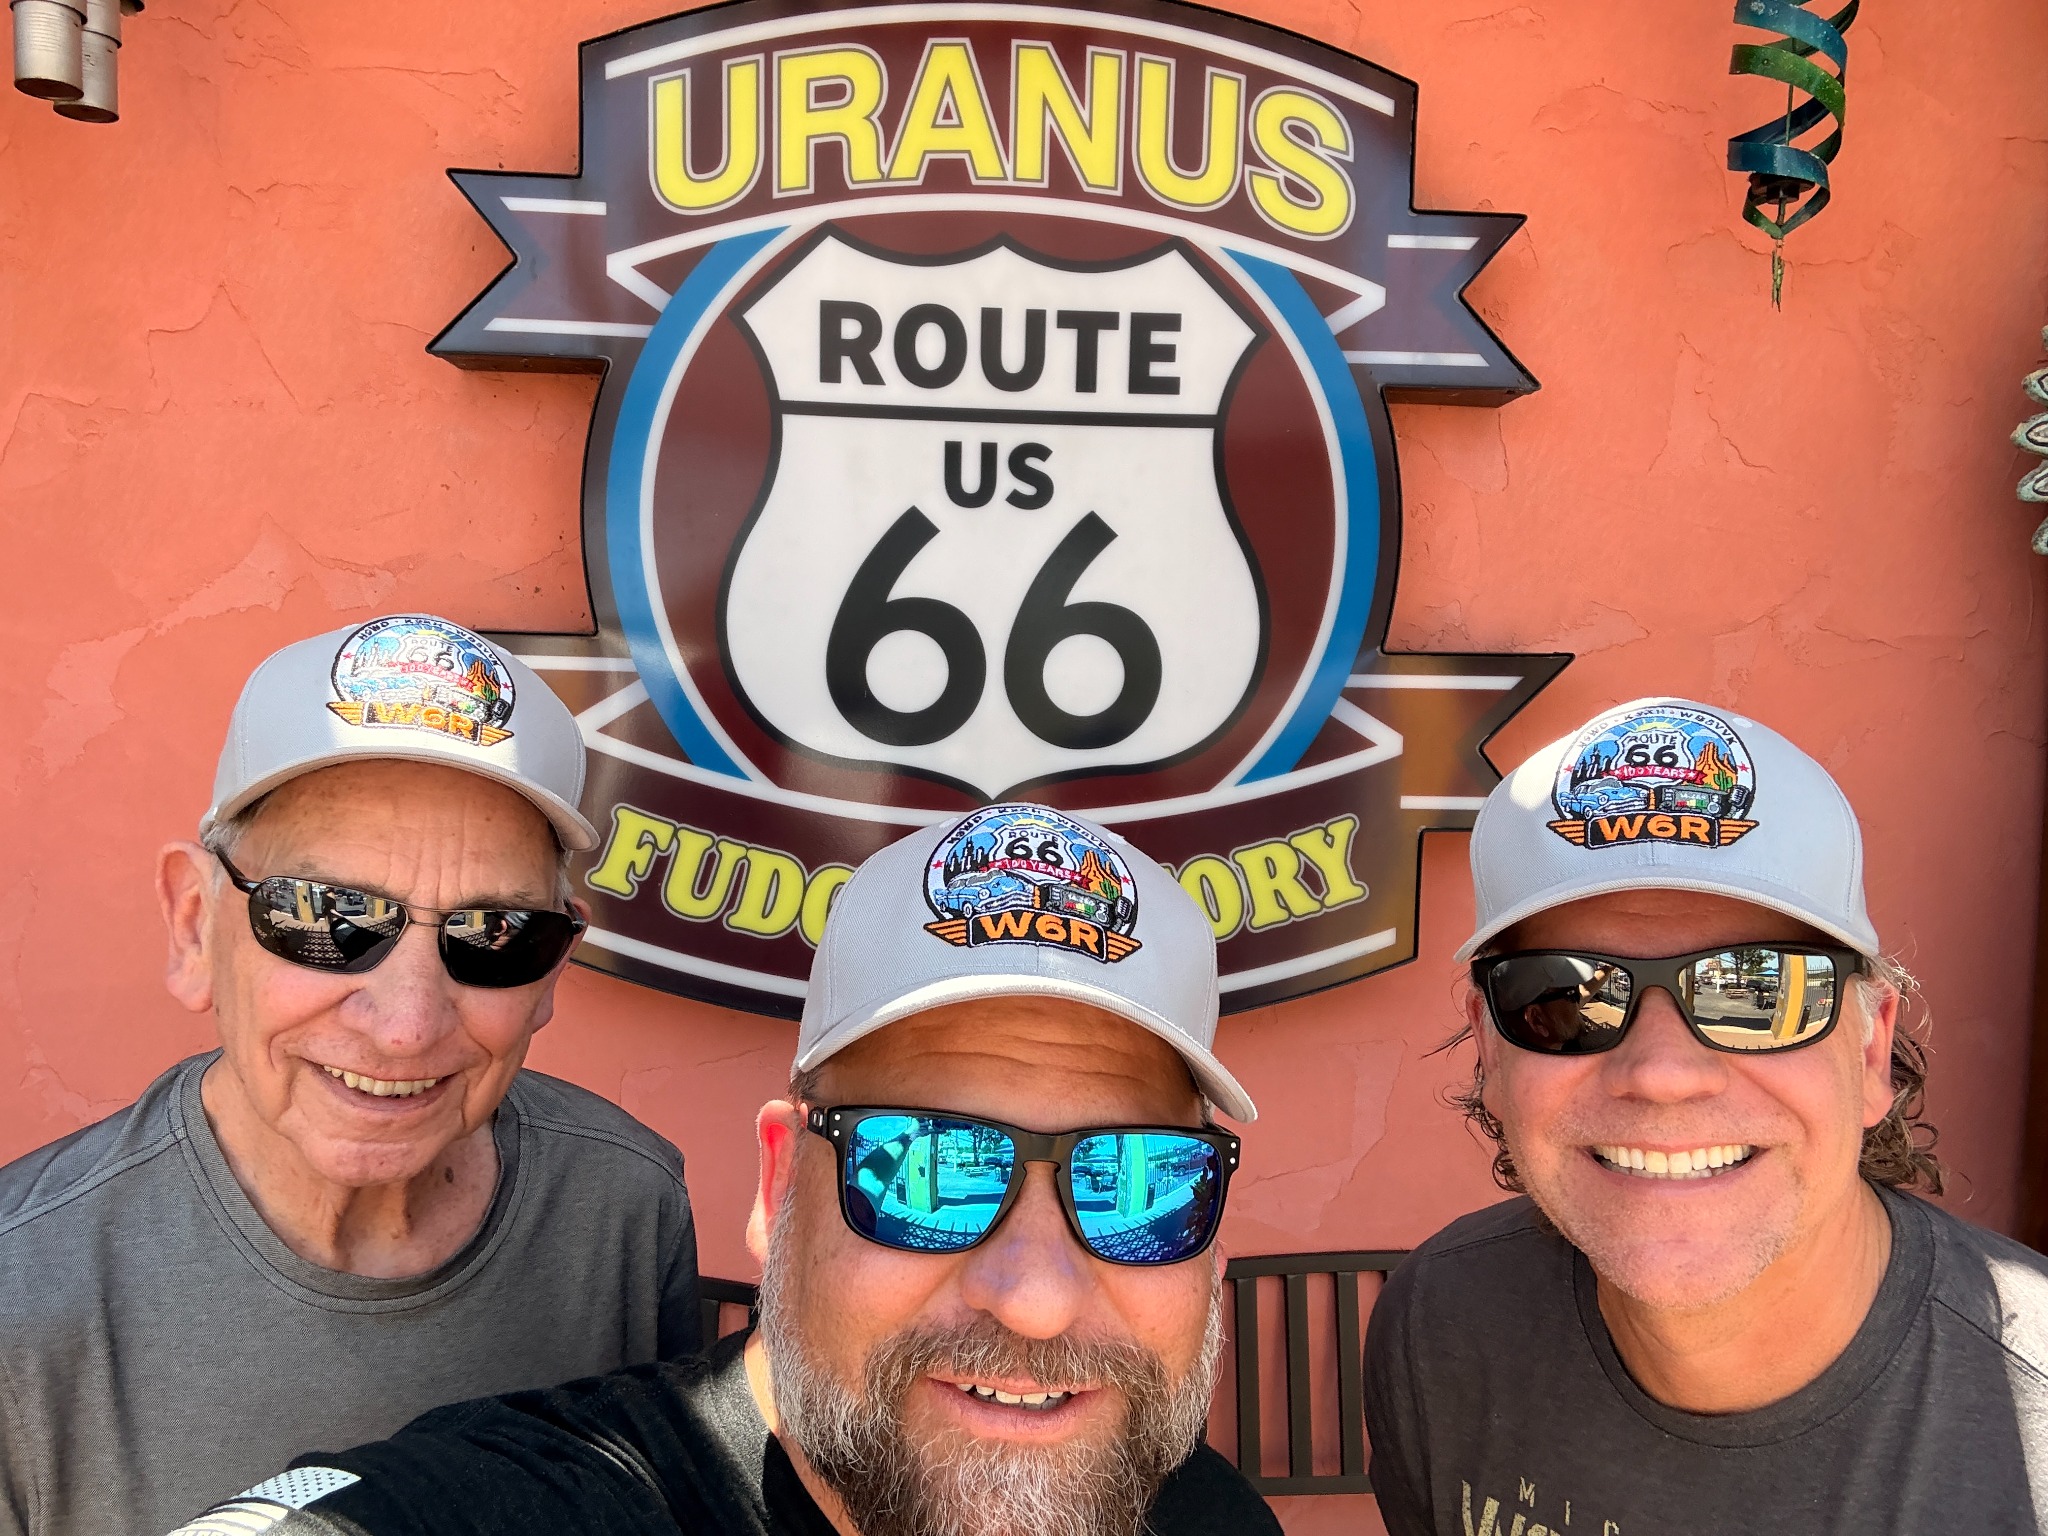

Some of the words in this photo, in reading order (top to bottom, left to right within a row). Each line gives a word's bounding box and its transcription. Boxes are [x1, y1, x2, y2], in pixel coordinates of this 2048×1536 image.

[648, 37, 1356, 242] URANUS
[818, 299, 1182, 396] ROUTE
[944, 440, 1055, 510] US
[826, 505, 1163, 750] 66
[375, 701, 475, 738] W6R
[1626, 734, 1678, 745] ROUTE
[1624, 744, 1679, 767] 66
[1623, 766, 1645, 778] 100
[1648, 766, 1686, 779] YEARS
[1008, 829, 1059, 847] ROUTE
[1597, 814, 1710, 844] W6R
[1004, 837, 1064, 868] 66
[1004, 859, 1028, 870] 100
[1029, 859, 1071, 881] YEARS
[978, 911, 1100, 954] W6R
